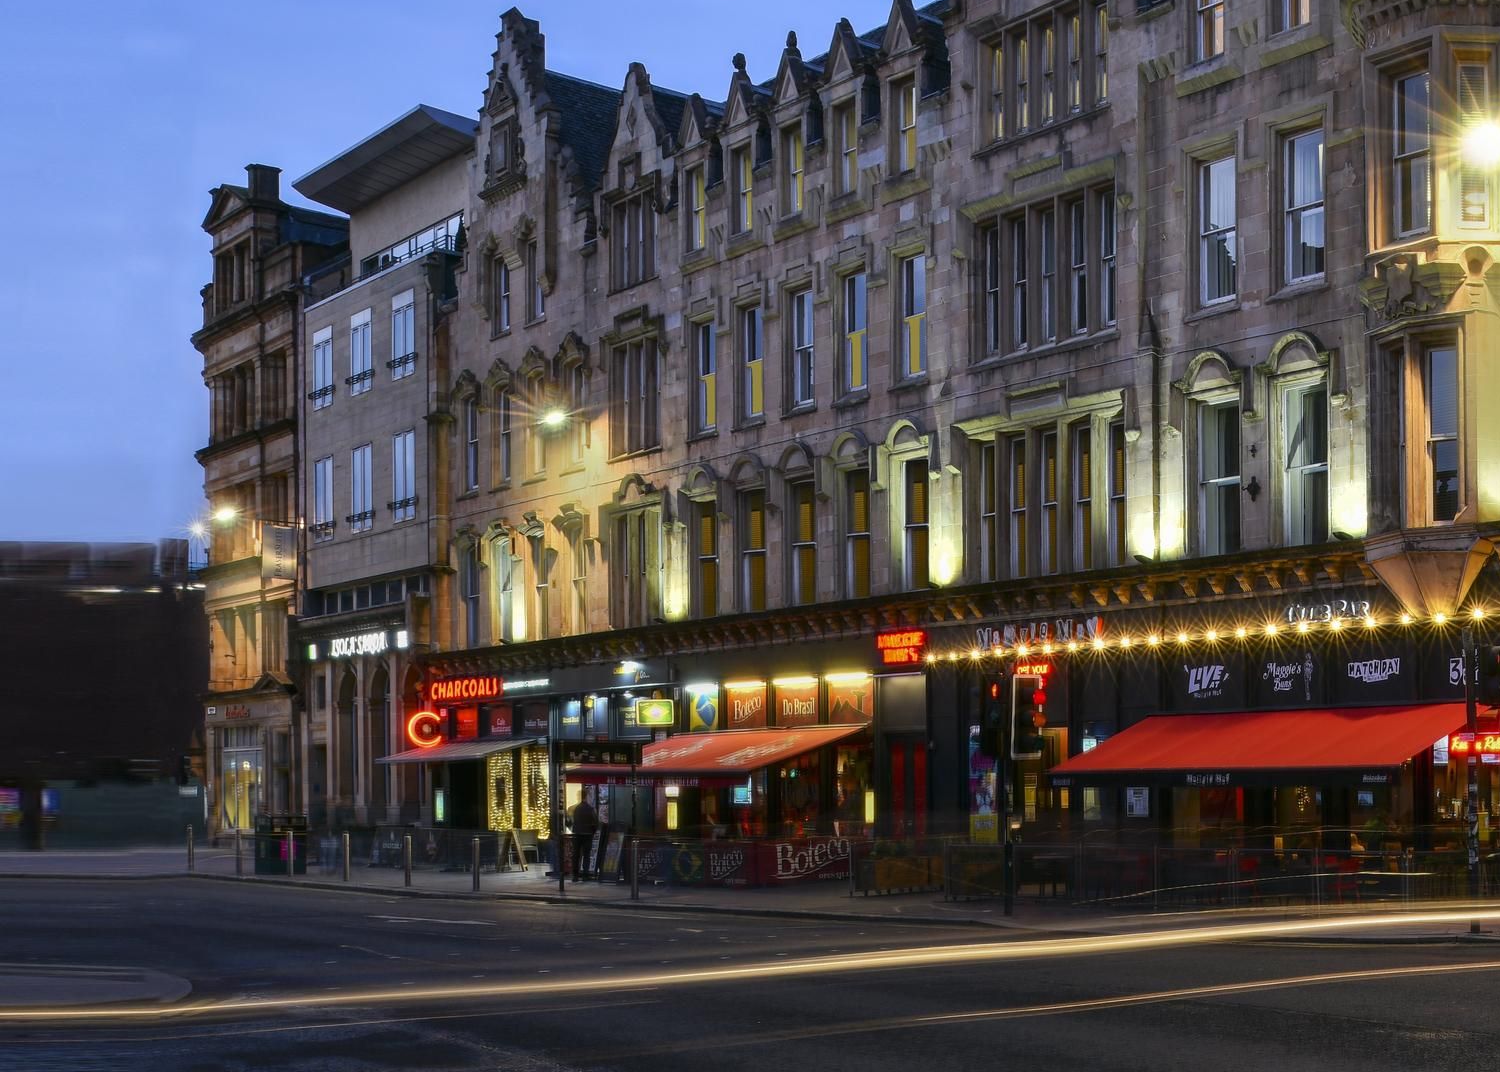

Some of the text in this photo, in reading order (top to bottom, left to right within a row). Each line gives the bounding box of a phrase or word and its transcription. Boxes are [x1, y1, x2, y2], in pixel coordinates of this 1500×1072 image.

[431, 678, 498, 700] CHARCOALS
[734, 696, 762, 721] Boteco
[783, 697, 815, 716] Do Brasil
[775, 839, 850, 876] Boteco
